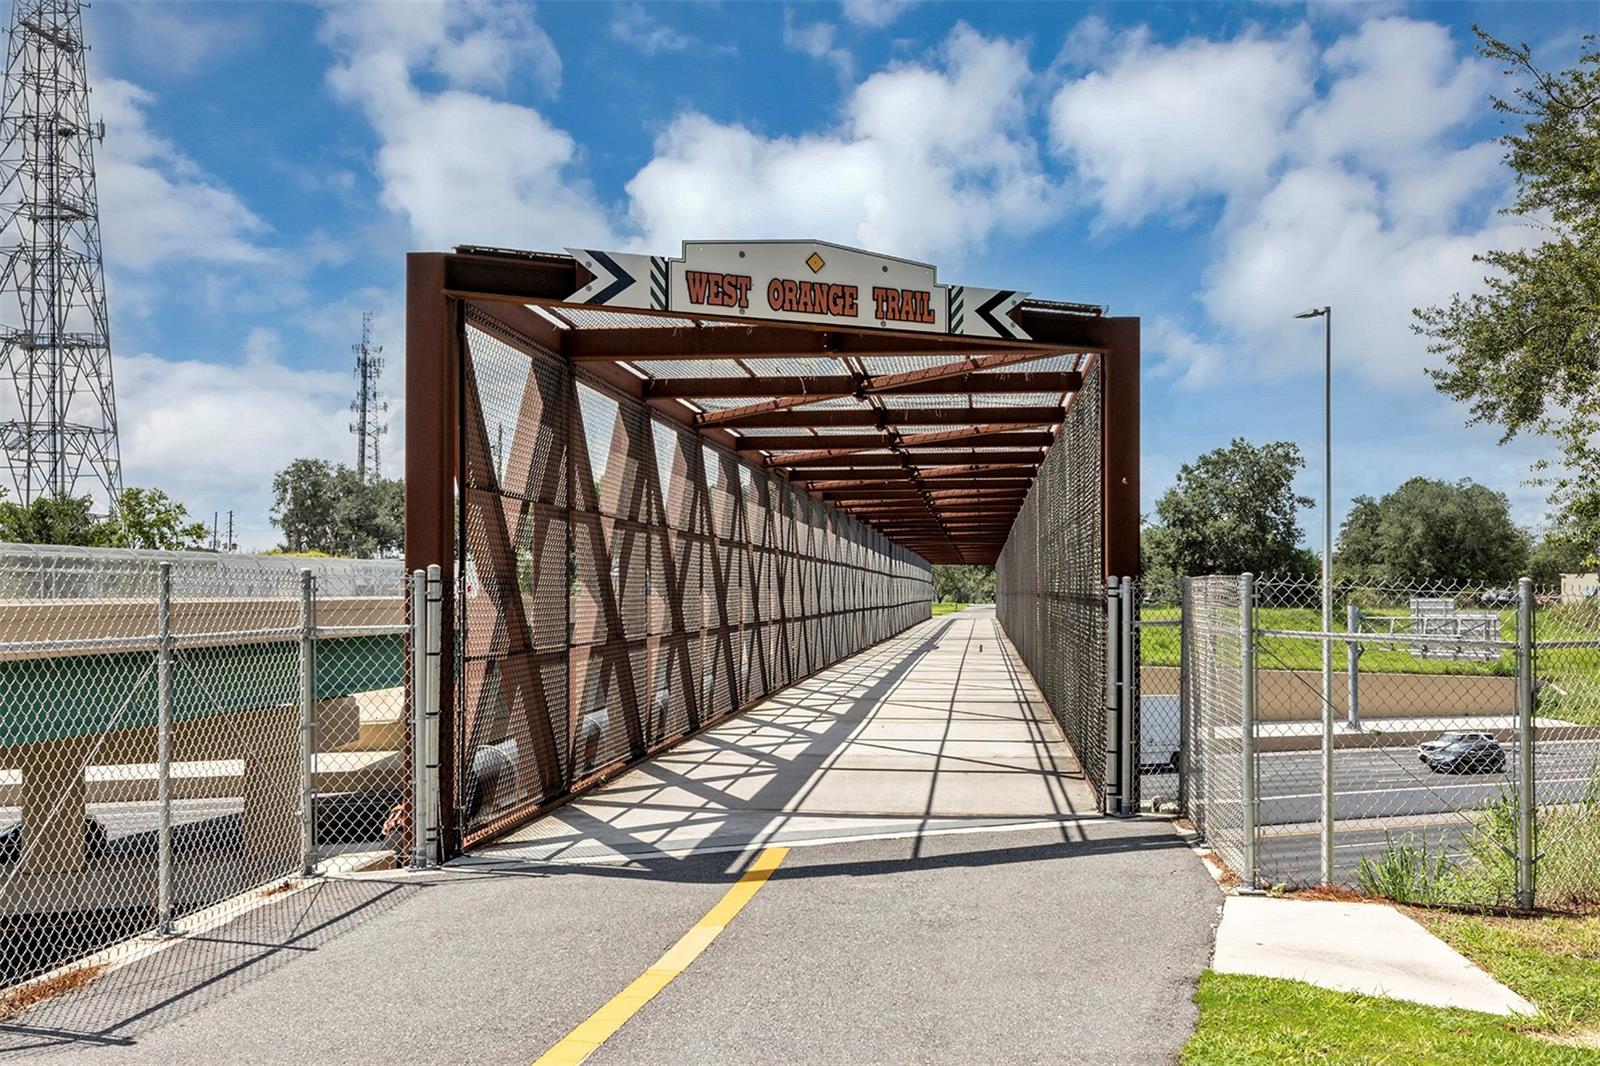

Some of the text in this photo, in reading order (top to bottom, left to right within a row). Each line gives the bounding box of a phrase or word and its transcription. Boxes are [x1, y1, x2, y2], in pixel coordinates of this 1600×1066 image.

[685, 270, 935, 324] WEST ORANGE TRAIL
